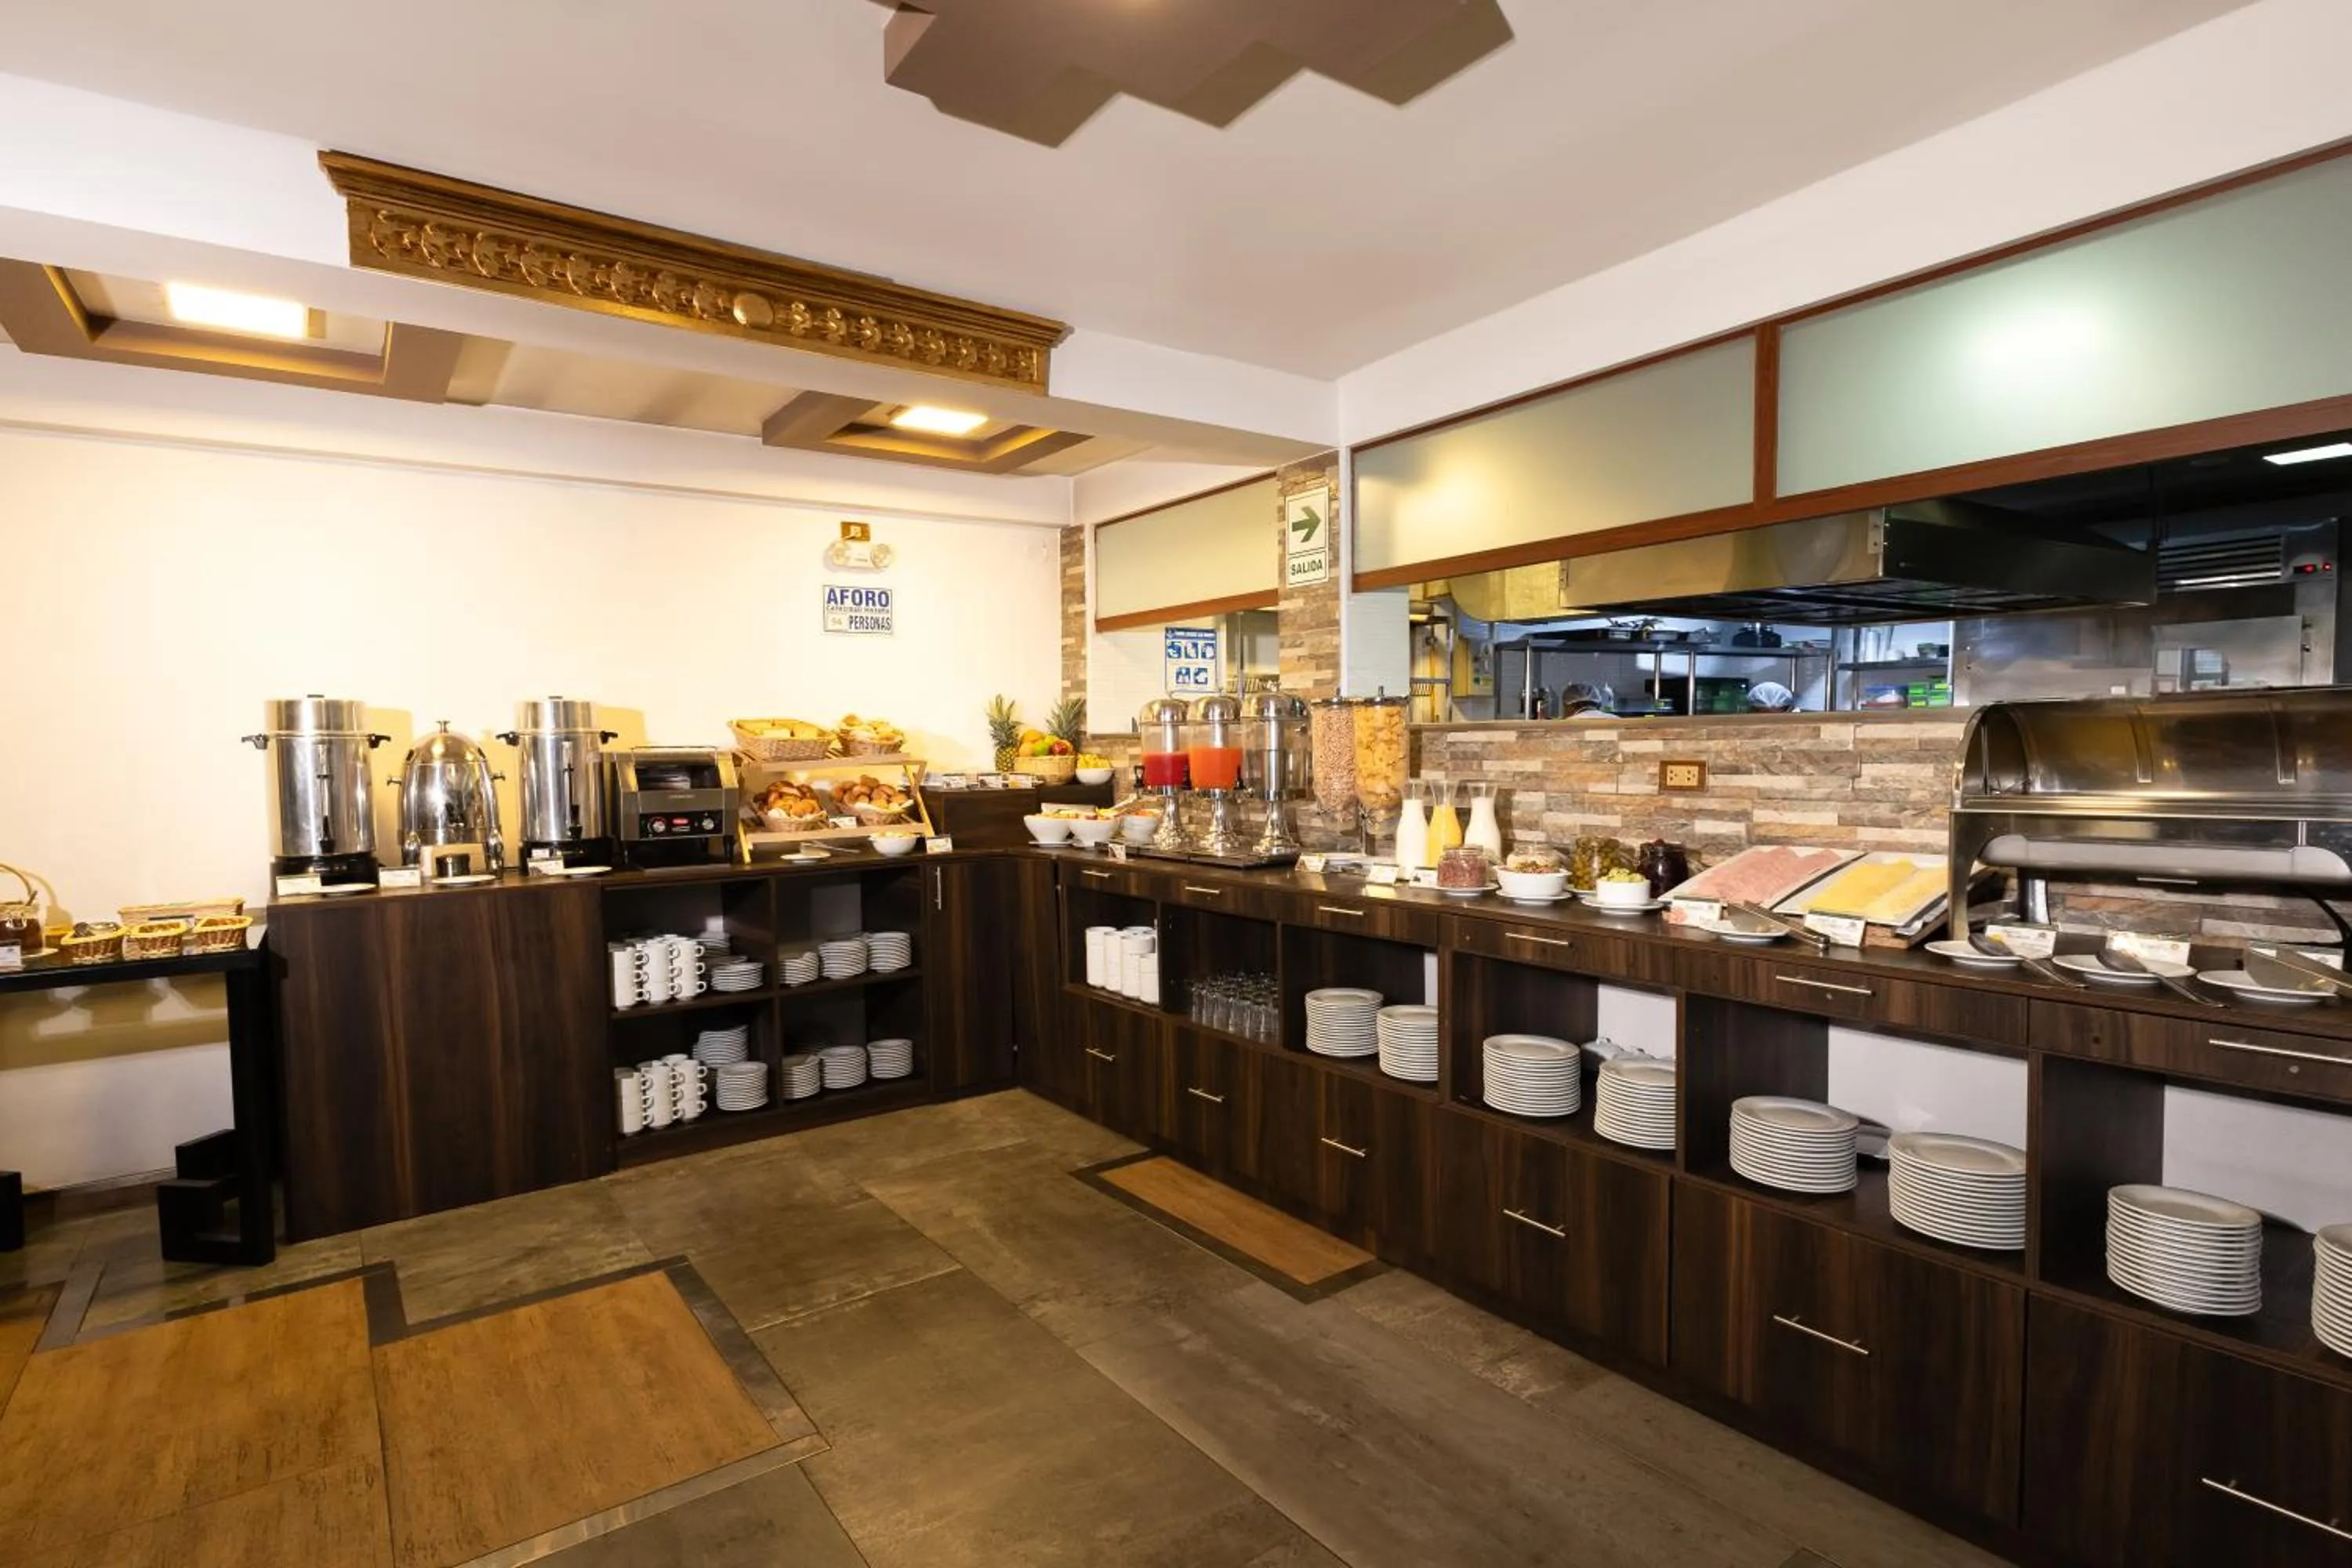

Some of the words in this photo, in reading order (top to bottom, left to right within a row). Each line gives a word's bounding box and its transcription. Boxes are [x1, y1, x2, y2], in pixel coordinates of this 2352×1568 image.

[1290, 559, 1323, 576] SALIDA
[826, 588, 890, 608] AFORO
[849, 615, 891, 630] PERSONAS
